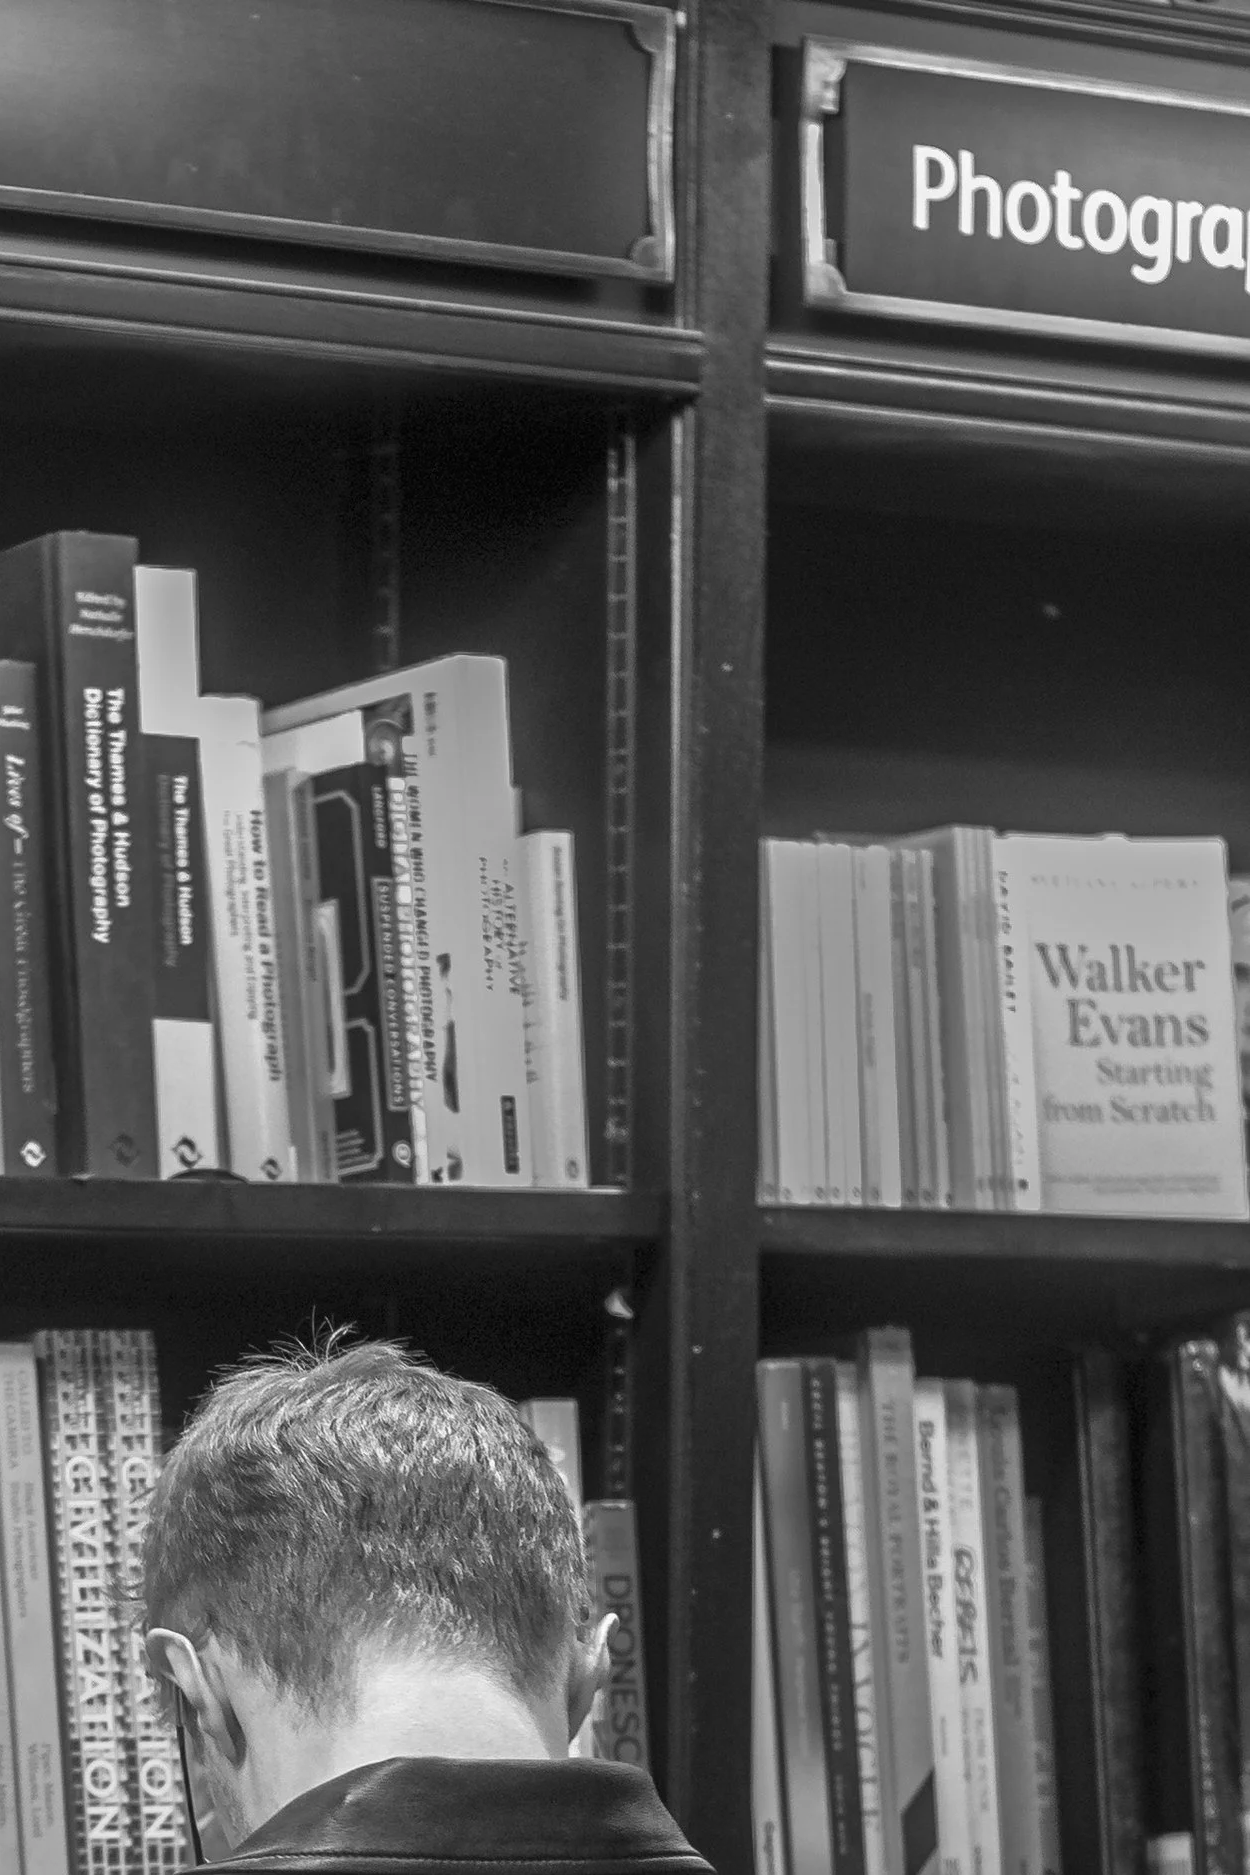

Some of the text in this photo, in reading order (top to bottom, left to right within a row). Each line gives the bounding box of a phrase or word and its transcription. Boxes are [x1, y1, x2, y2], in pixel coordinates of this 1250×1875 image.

[913, 144, 1250, 296] Photogra
[83, 687, 114, 944] Dictionary of Photography
[106, 688, 133, 908] The Thames & Hudson
[172, 775, 194, 945] The Thames & Hudson
[250, 810, 282, 1082] How to Read a Photograph
[379, 884, 395, 974] SUSPENDED
[504, 883, 521, 995] ALTERNATIVE
[1035, 942, 1206, 992] Walker
[384, 979, 404, 1104] CONVERSATIONS
[418, 965, 438, 1082] PHOTOGRAPHY
[1067, 997, 1210, 1047] Evans
[1096, 1057, 1213, 1091] Starting
[1110, 1088, 1215, 1123] Scratch
[918, 1420, 937, 1494] Bernd
[925, 1518, 941, 1569] Hilla
[64, 1455, 122, 1839] CIVILIZATION
[926, 1574, 945, 1659] Becher
